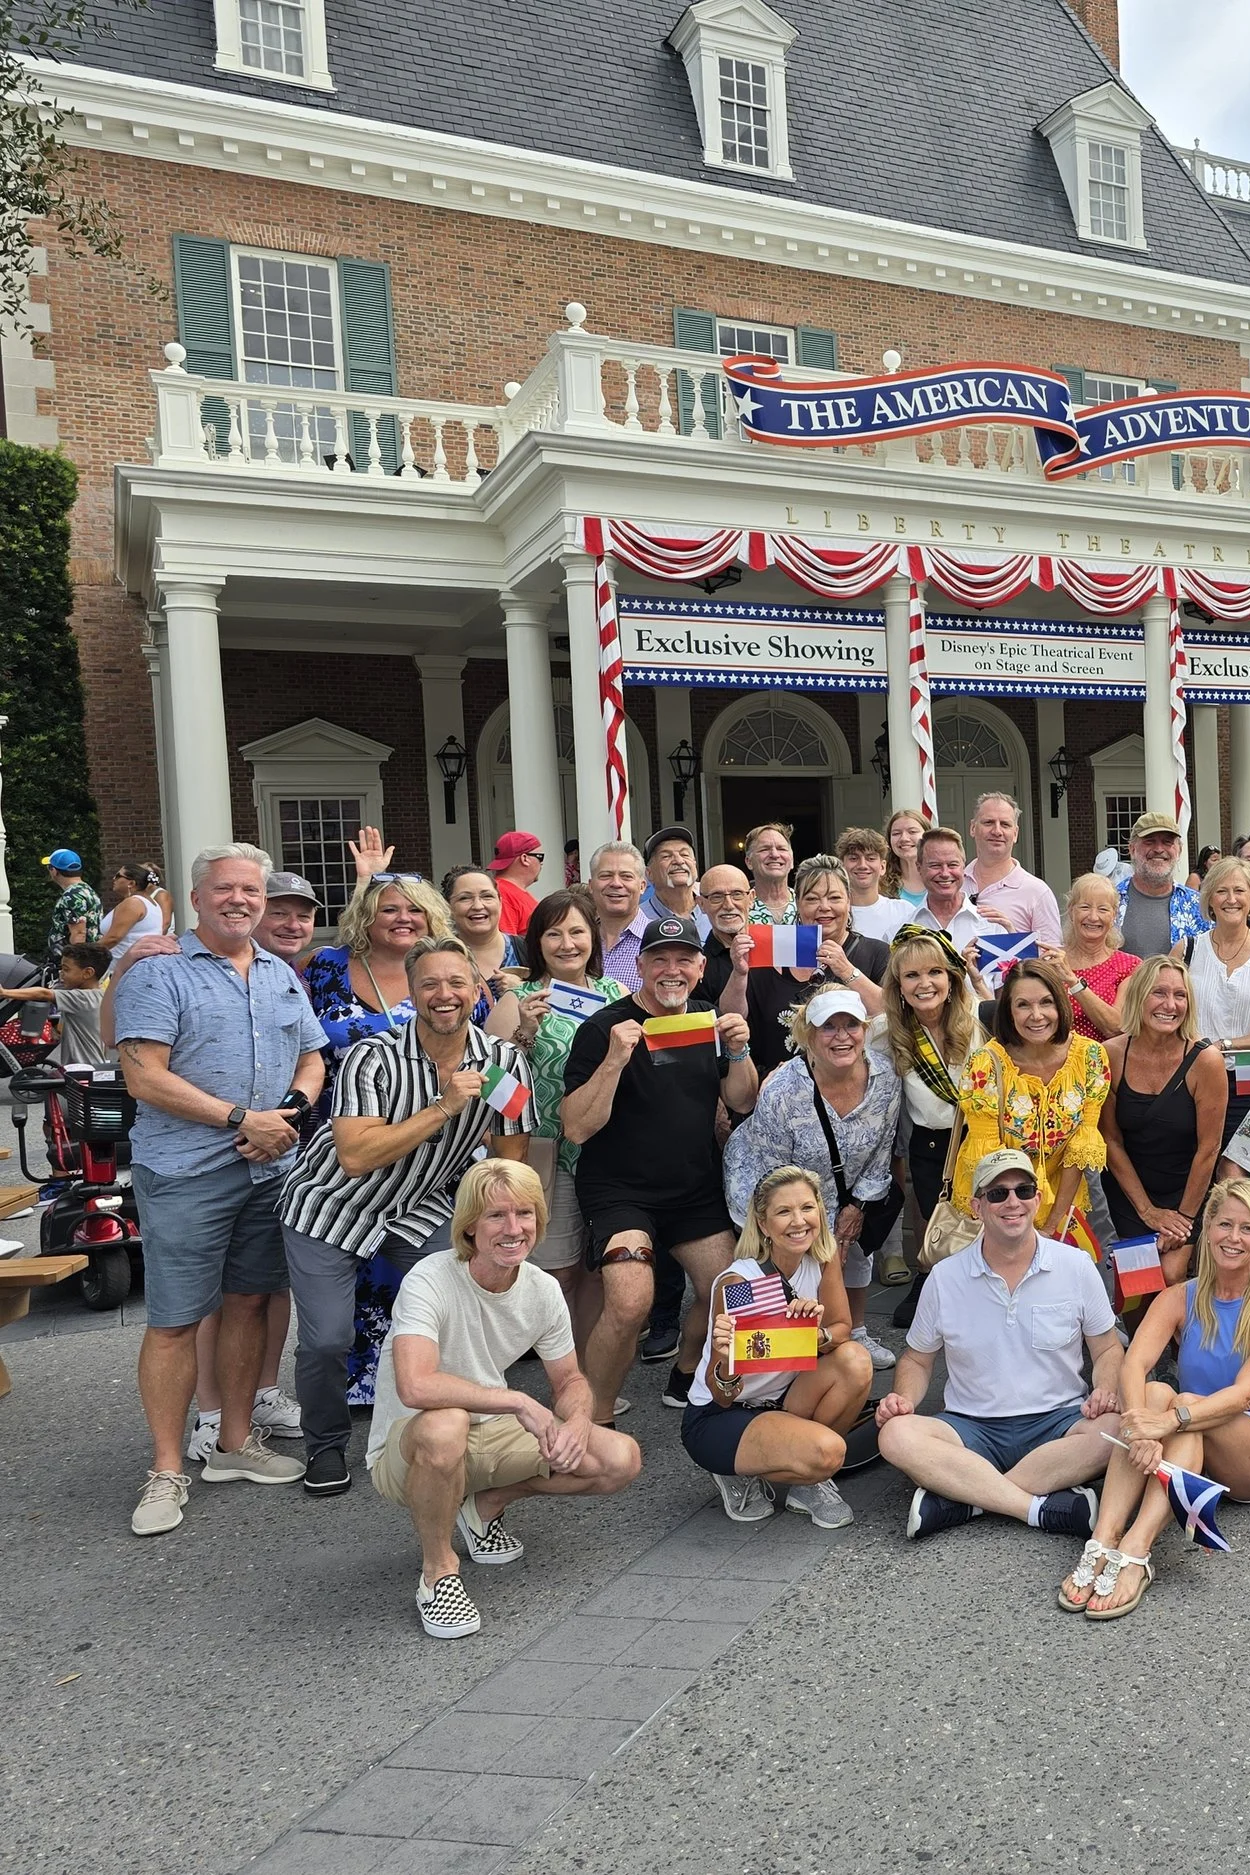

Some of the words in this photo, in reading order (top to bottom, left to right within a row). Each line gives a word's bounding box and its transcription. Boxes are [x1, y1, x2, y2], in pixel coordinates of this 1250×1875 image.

[781, 397, 862, 431] THE
[871, 377, 1049, 424] AMERICAN
[786, 506, 1007, 543] LIBERTY
[634, 629, 761, 657] Exclusive
[768, 635, 875, 667] Showing
[940, 639, 995, 657] Disney's
[999, 642, 1028, 659] Epic
[1030, 644, 1095, 660] Theatrical
[1098, 648, 1134, 661] Event
[974, 661, 992, 671] on
[996, 659, 1031, 674] Stage
[1034, 660, 1059, 673] and
[1062, 663, 1105, 675] Screen
